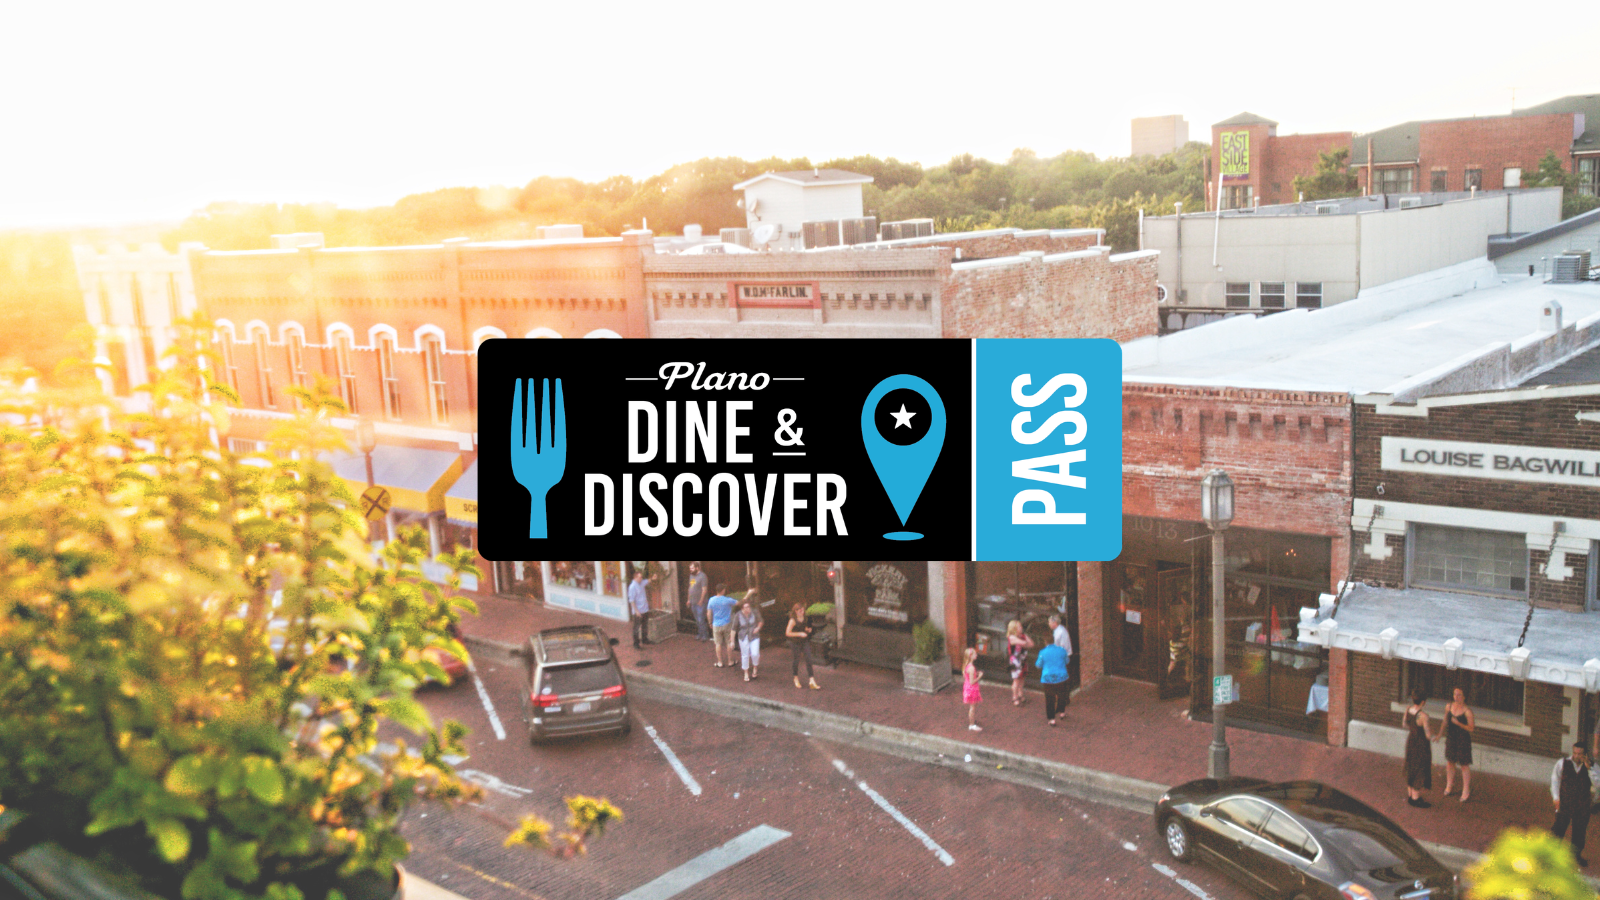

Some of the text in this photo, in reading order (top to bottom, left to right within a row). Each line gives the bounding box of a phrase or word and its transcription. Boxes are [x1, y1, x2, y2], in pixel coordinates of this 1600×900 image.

[1222, 134, 1247, 151] EAST
[1222, 150, 1247, 166] SIDE
[1401, 448, 1484, 468] LOUISE
